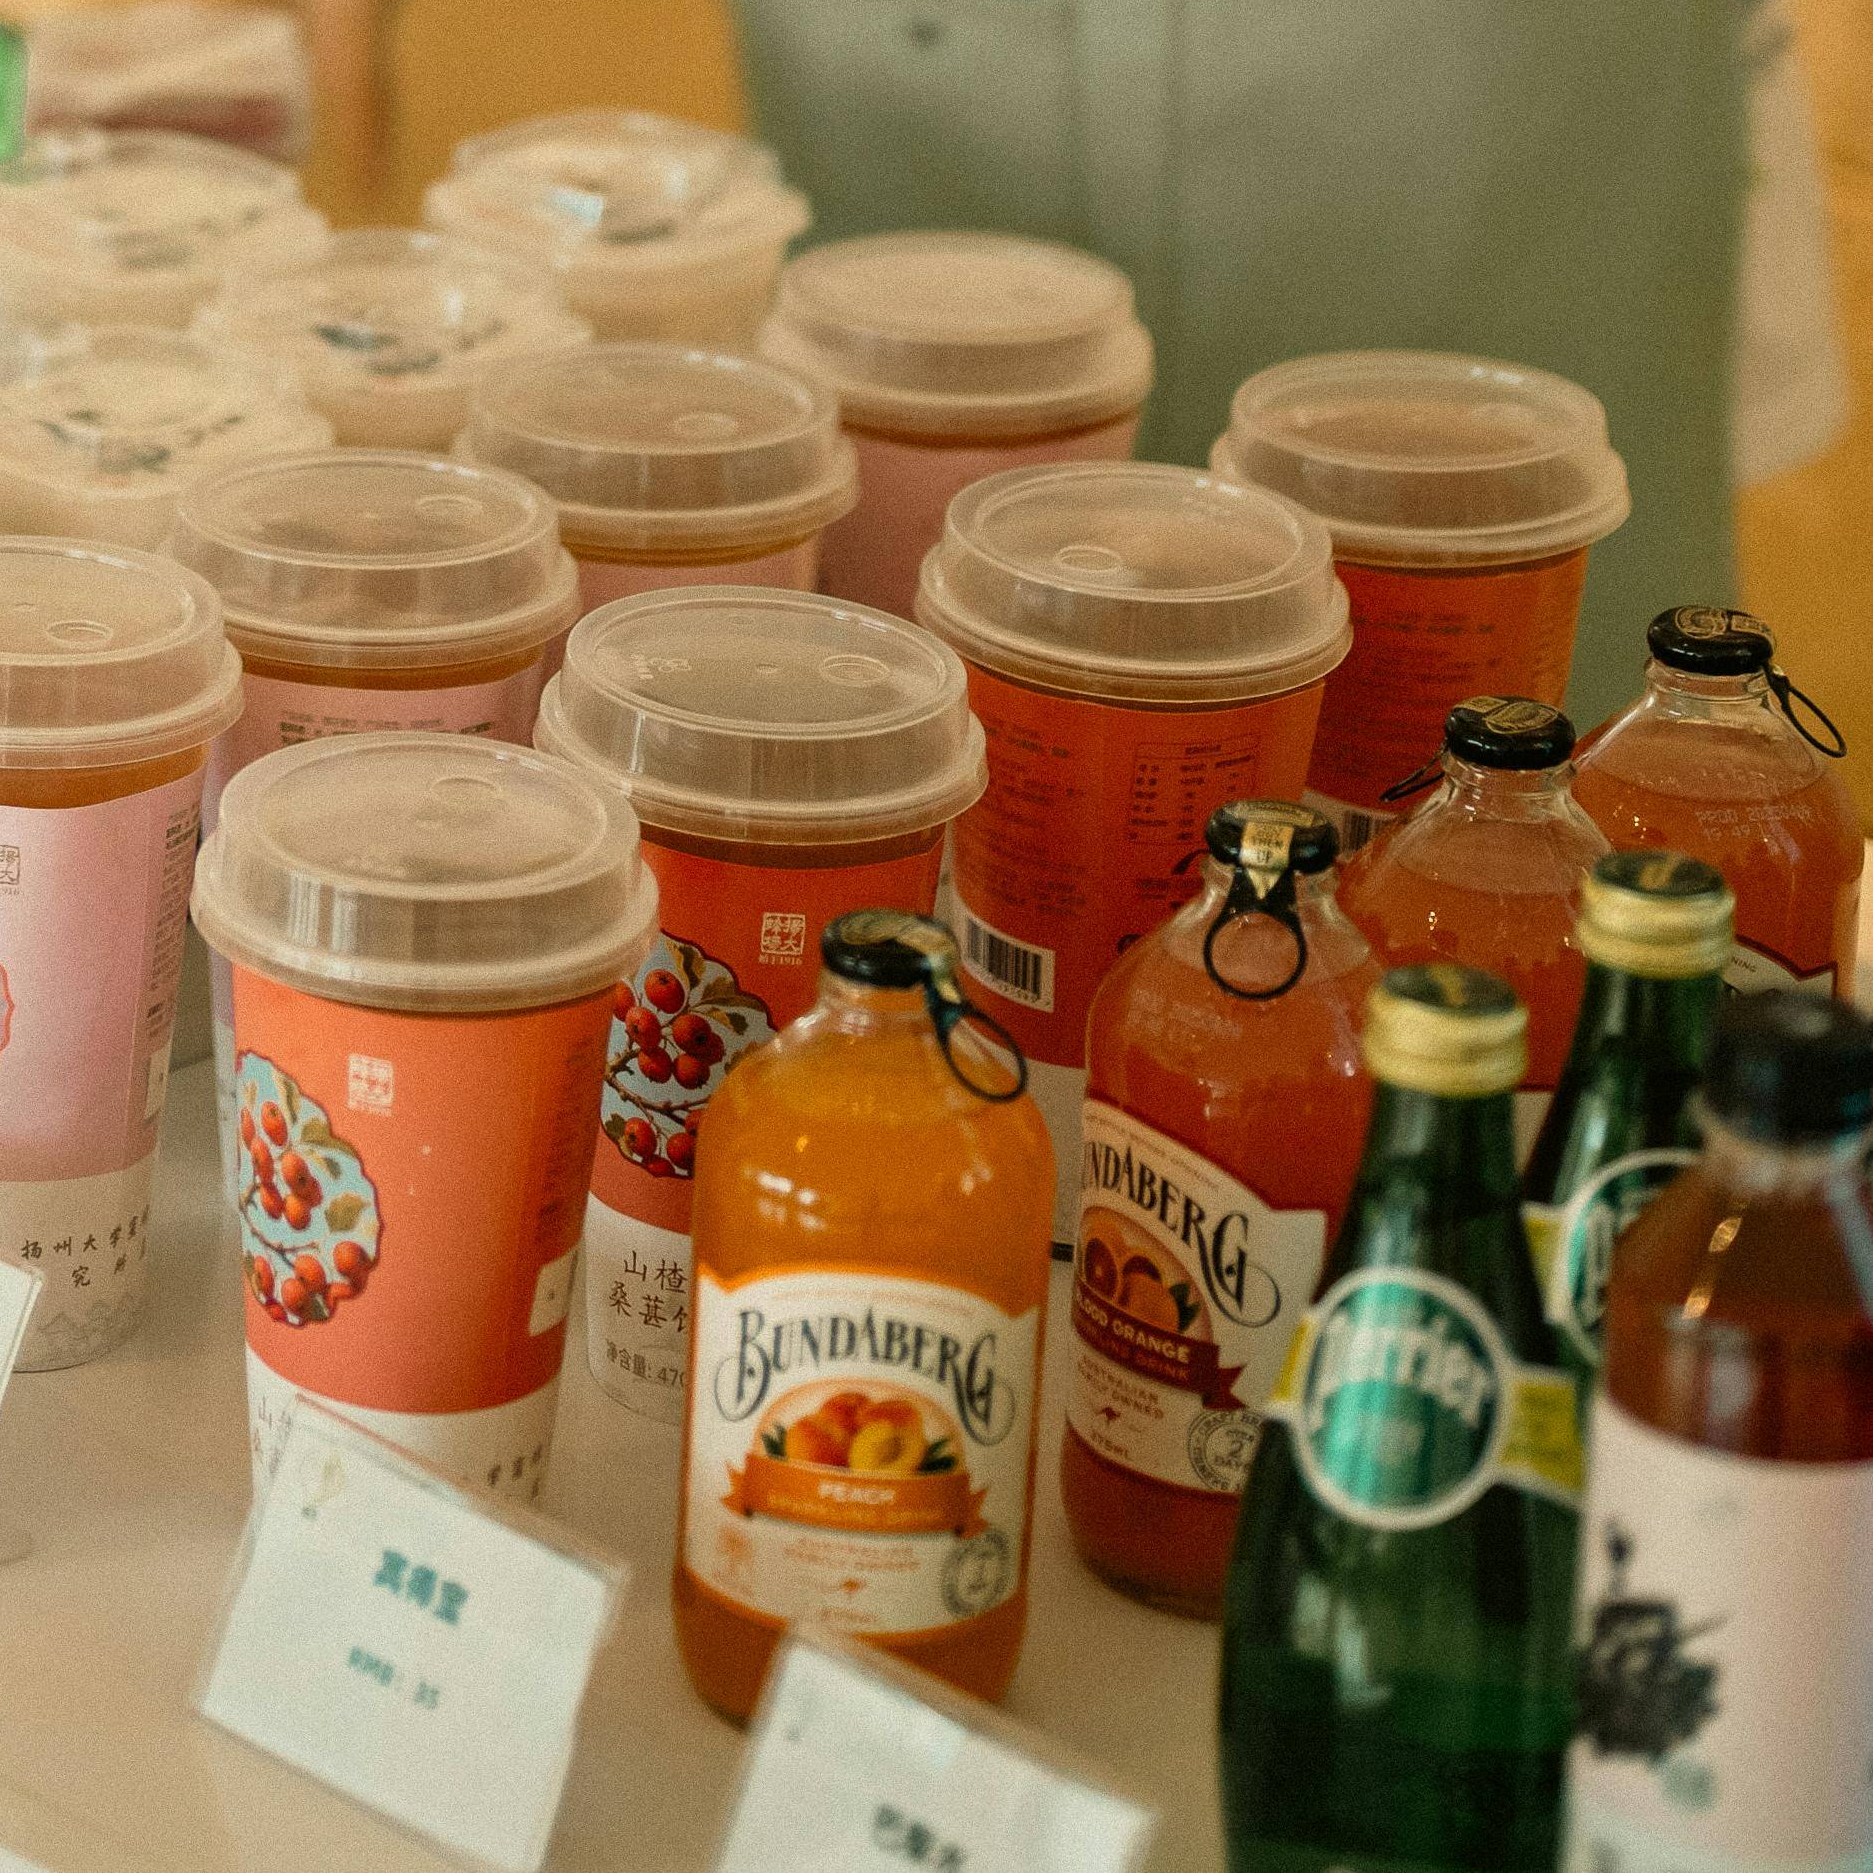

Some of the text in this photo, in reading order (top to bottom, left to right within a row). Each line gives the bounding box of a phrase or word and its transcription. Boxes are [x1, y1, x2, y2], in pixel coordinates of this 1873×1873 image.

[623, 1250, 688, 1294] 山楂
[1112, 1319, 1191, 1364] ORANGE
[714, 1306, 1016, 1447] BUNDABERG
[1111, 1389, 1164, 1420] OWNED
